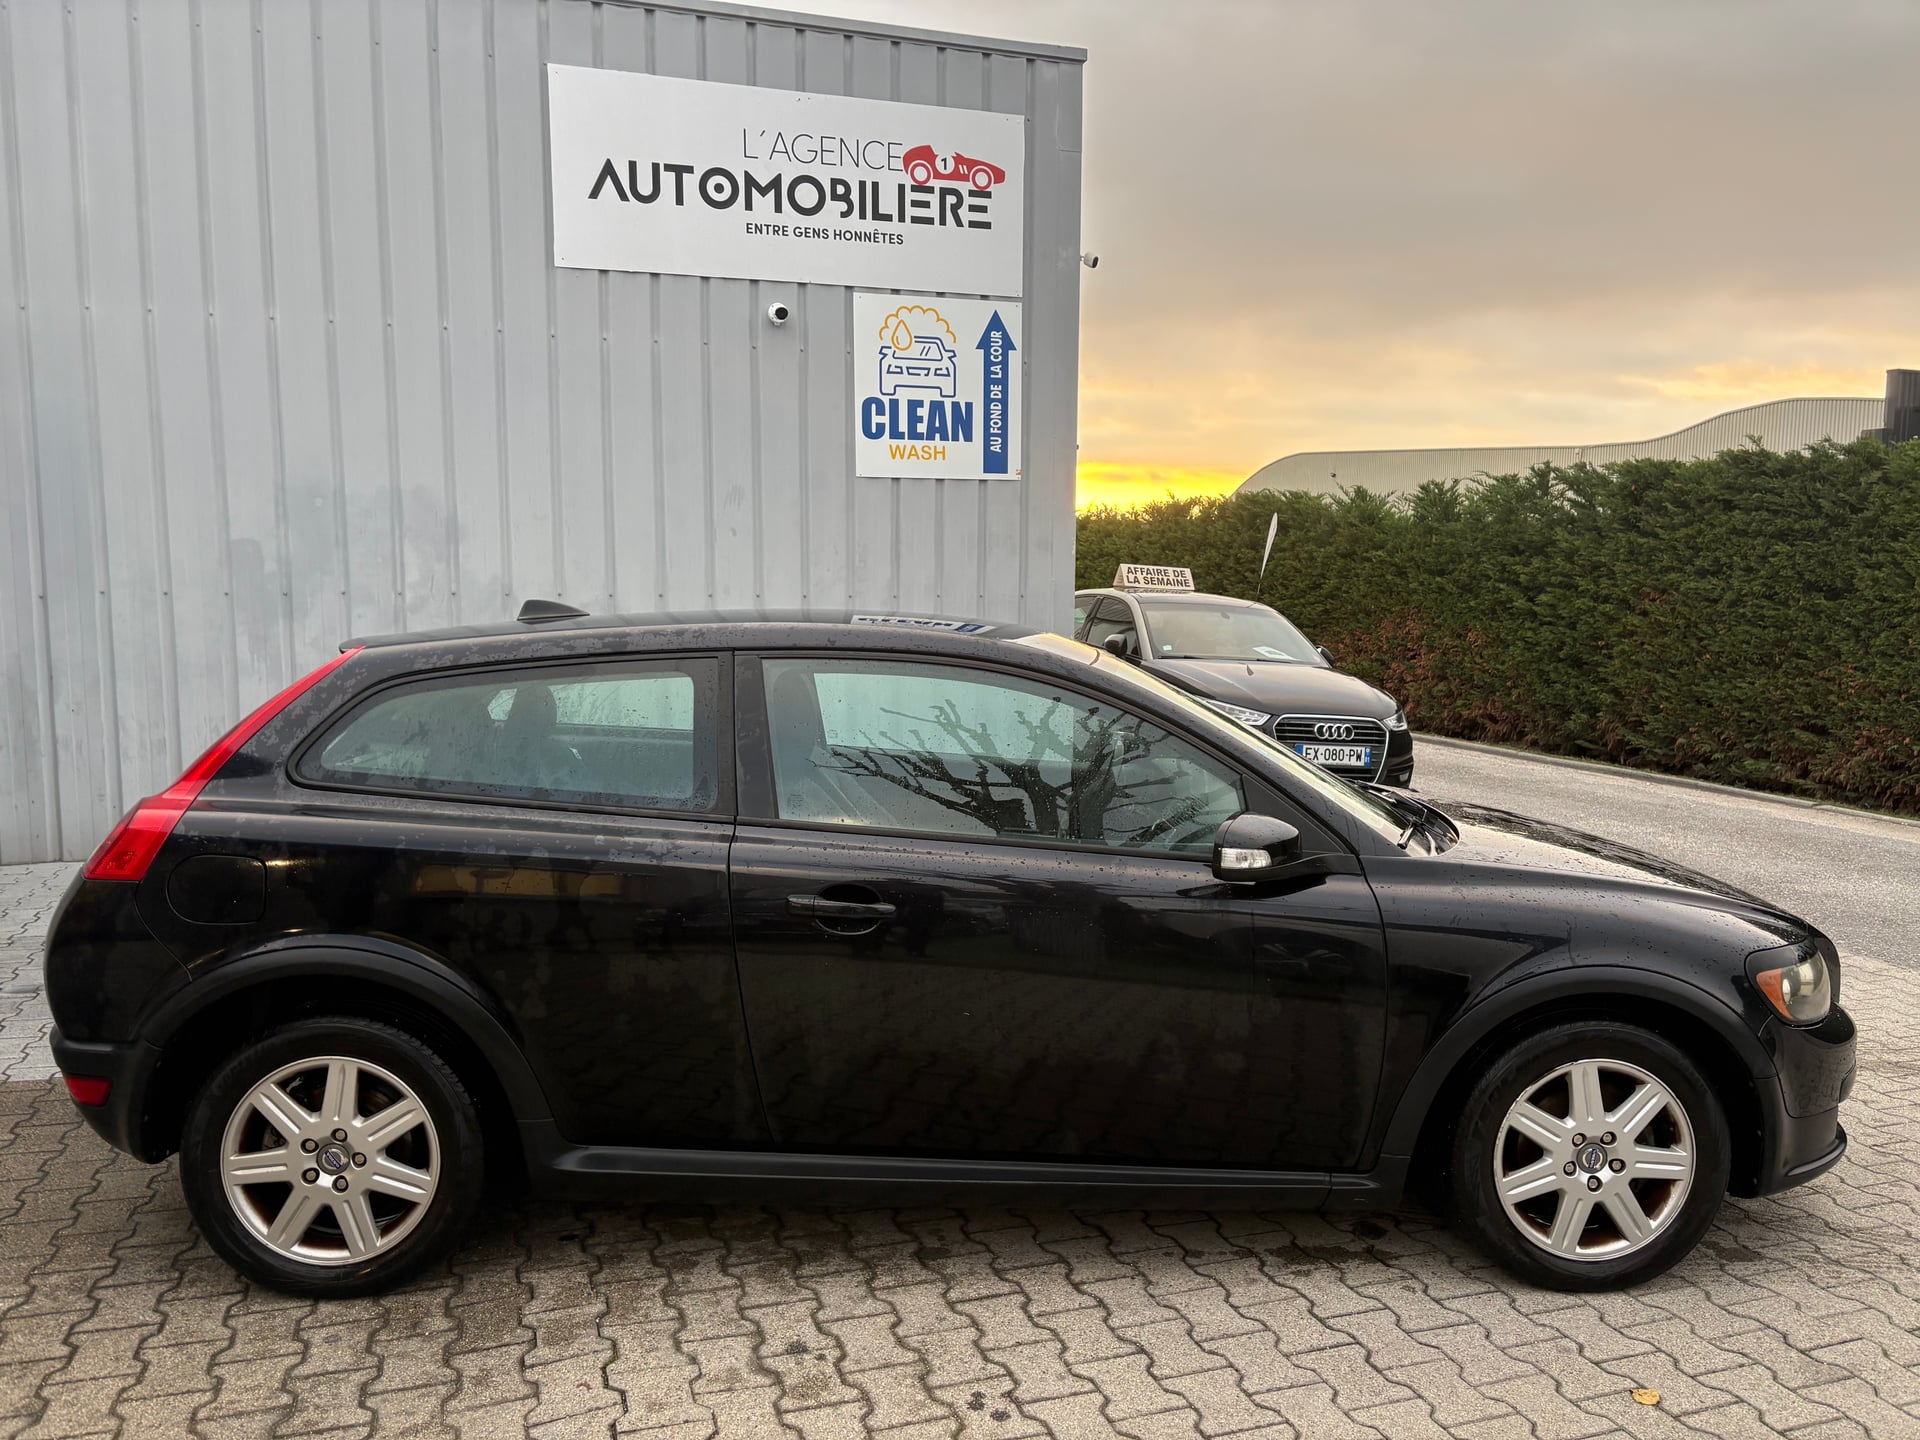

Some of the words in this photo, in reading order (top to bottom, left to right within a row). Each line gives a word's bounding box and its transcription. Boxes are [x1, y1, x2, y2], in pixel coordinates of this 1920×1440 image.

[588, 158, 992, 230] AUTOMOBILIERE
[745, 222, 789, 238] ENTRE
[793, 226, 829, 241] GENS
[833, 228, 904, 245] HONNÊTES
[990, 330, 1003, 362] COUR
[990, 364, 1002, 379] LA
[990, 384, 1002, 399] DE
[861, 396, 974, 443] CLEAN
[990, 401, 1002, 432] FOND
[889, 444, 946, 461] WASH
[990, 436, 1002, 453] AU
[1127, 566, 1171, 578] AFFAIRE
[1173, 569, 1187, 579] DE
[1126, 575, 1141, 585] LA
[1143, 576, 1191, 588] SEMAINE
[1305, 746, 1363, 763] EX-080-PW
